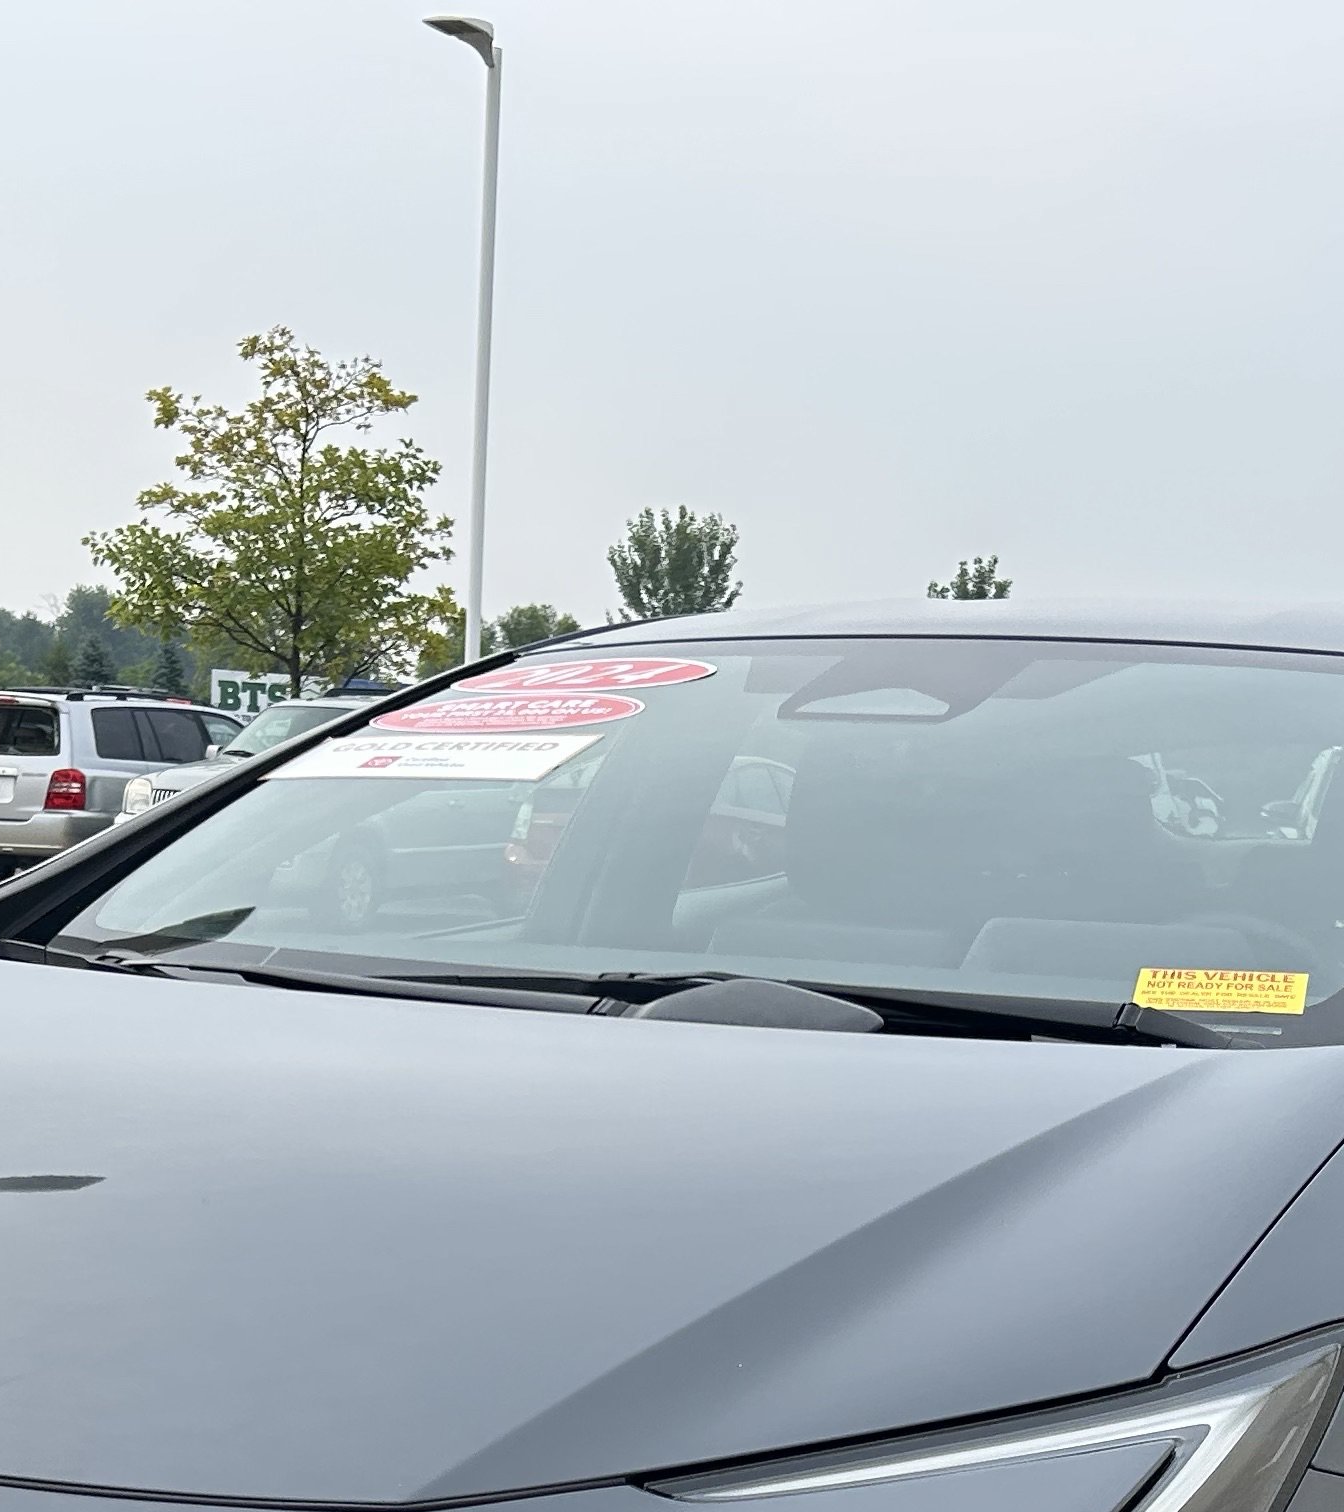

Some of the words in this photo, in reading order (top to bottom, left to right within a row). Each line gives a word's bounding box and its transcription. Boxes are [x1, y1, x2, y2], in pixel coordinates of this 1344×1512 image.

[474, 663, 690, 689] 2024
[436, 700, 529, 712] SMART
[528, 699, 599, 708] CARE
[446, 708, 499, 718] FIRST
[333, 742, 413, 752] GOLD
[415, 742, 560, 752] CERTIFIED
[1151, 970, 1197, 980] THIS
[1204, 971, 1296, 984] VEHICLE
[1147, 980, 1174, 989] NOT
[1177, 981, 1224, 990] READY
[1226, 982, 1254, 992] FOR
[1257, 984, 1293, 993] SALE
